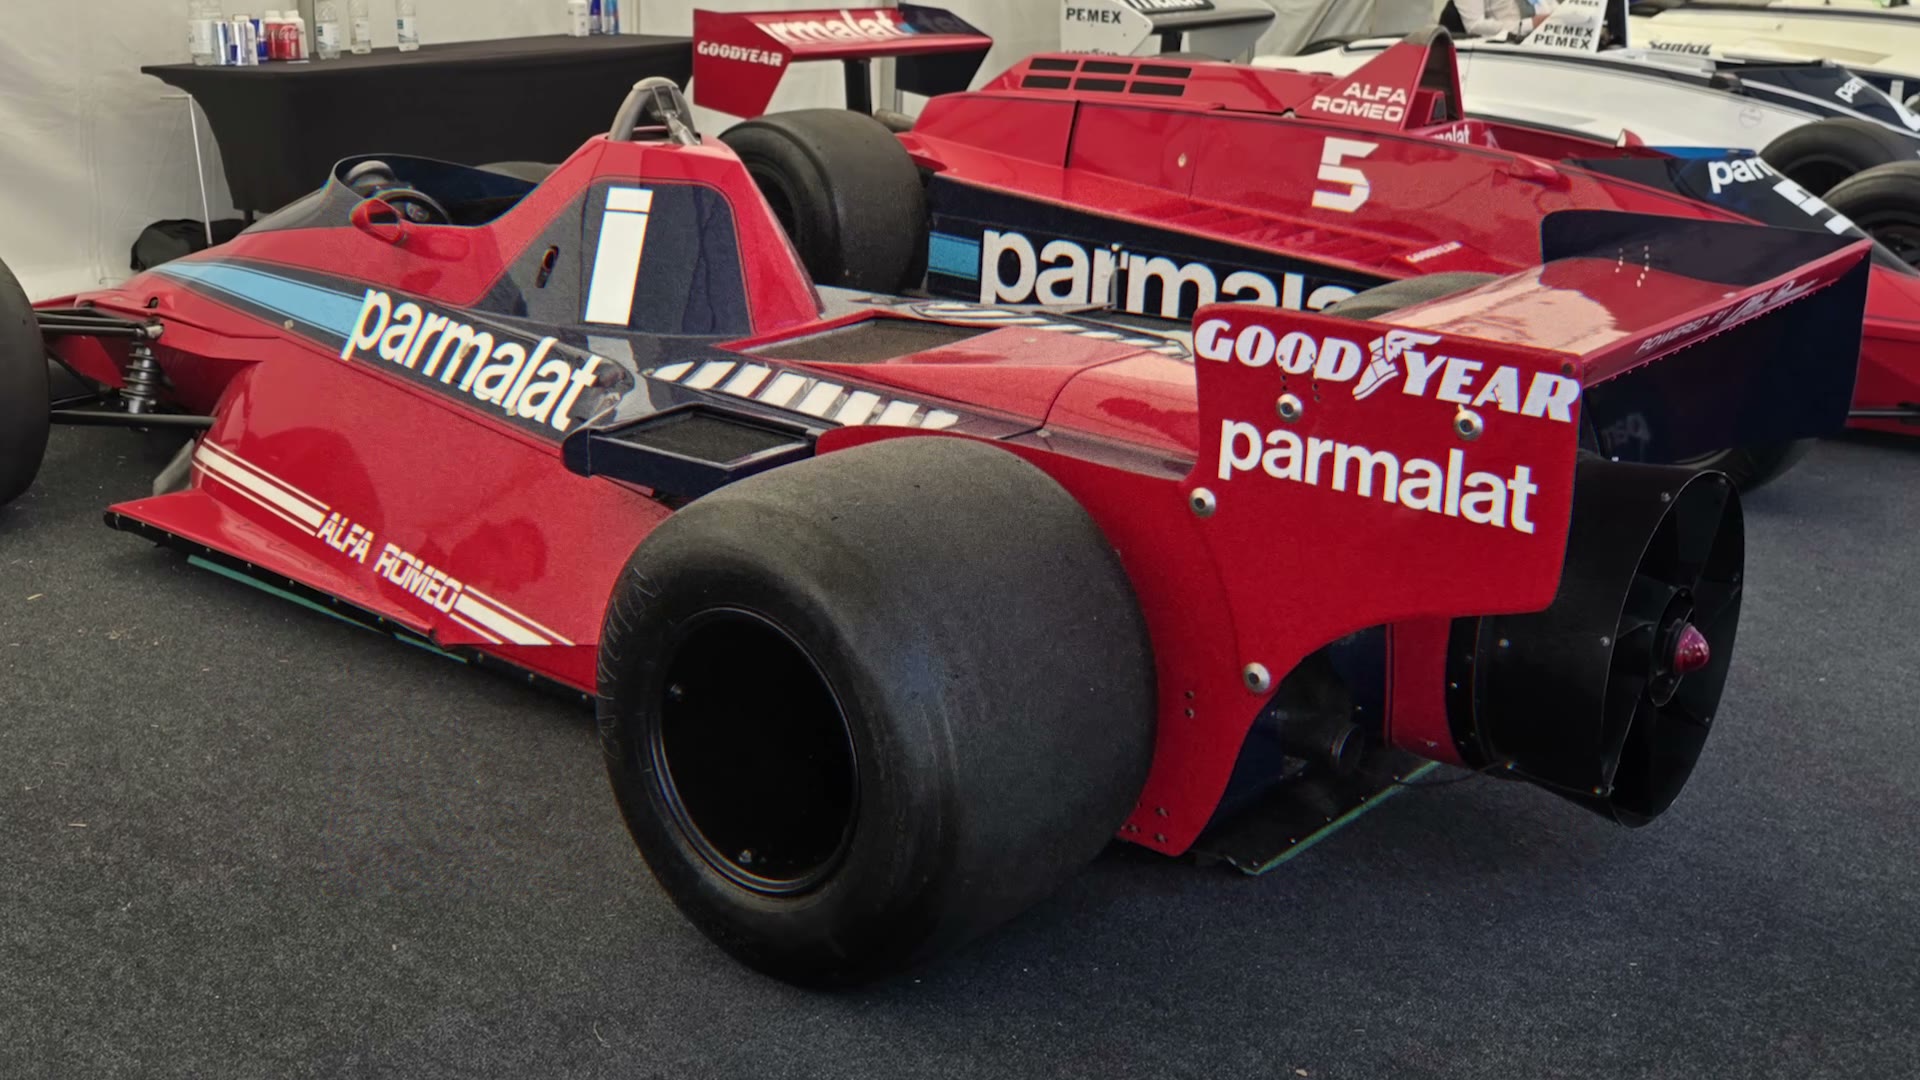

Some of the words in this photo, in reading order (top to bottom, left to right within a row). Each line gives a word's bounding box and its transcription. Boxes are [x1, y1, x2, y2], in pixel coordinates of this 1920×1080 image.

[755, 10, 908, 43] rmalat
[1066, 8, 1121, 24] PEMEX
[1534, 34, 1591, 50] PEMEX
[1543, 24, 1594, 38] PEMEX
[697, 41, 782, 67] GOODYEAR
[1342, 82, 1407, 105] ALFA
[1311, 95, 1404, 122] ROMEO
[1311, 136, 1379, 212] 5
[340, 289, 602, 432] parmalat
[1218, 418, 1539, 534] parmalat
[316, 512, 374, 564] ALFA
[373, 542, 463, 614] ROMEO
